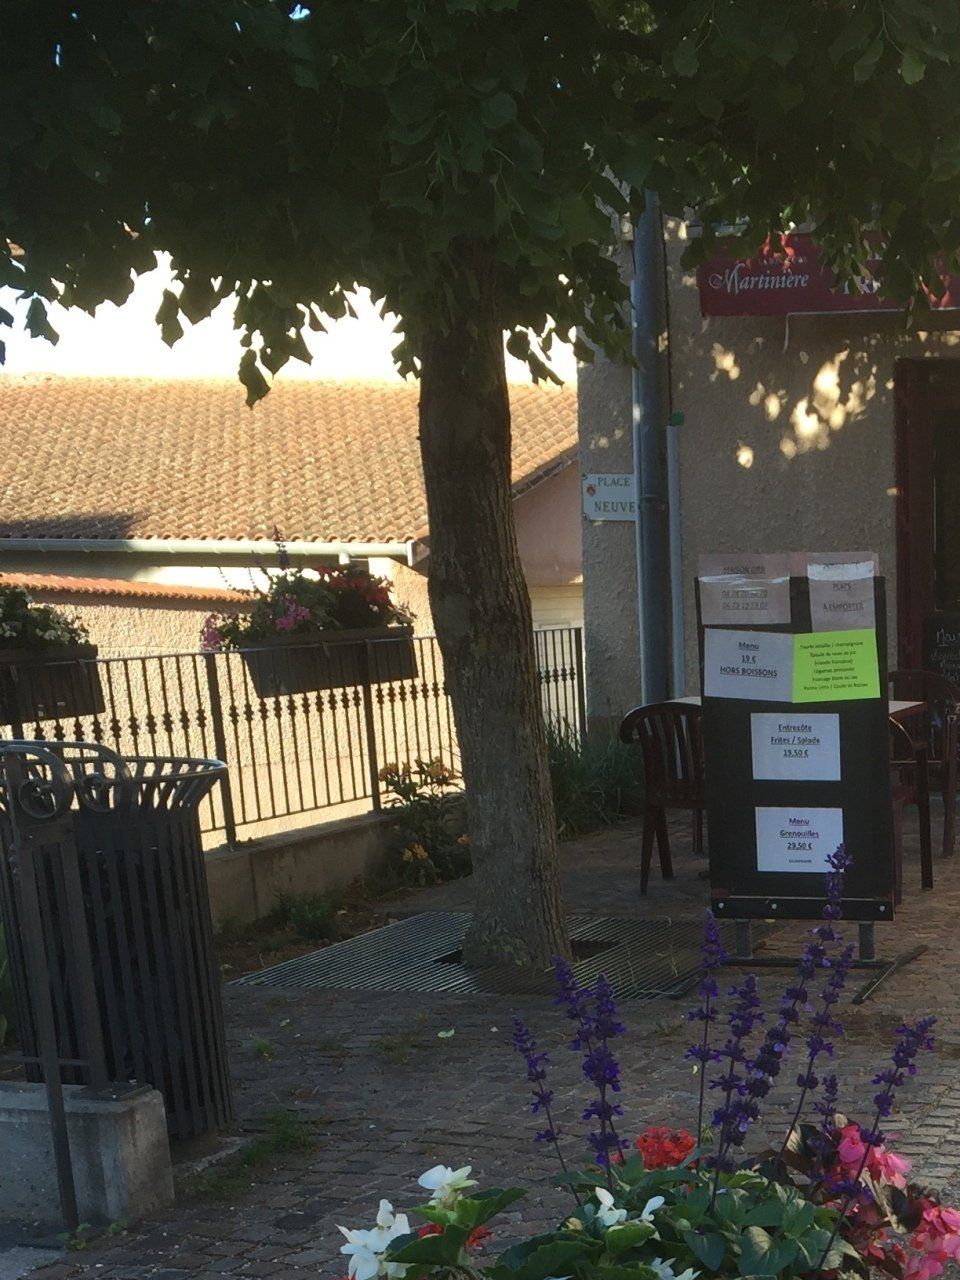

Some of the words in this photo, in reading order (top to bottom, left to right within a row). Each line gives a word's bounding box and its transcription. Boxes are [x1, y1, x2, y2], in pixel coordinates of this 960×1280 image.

[708, 262, 810, 295] Martinière
[597, 477, 631, 487] PLACE
[594, 501, 636, 513] NEUVE
[738, 642, 760, 650] Menu
[720, 666, 740, 675] HORS
[742, 668, 778, 678] BOISSONS
[778, 724, 812, 732] Entrecôte
[779, 830, 819, 838] Grenouilles
